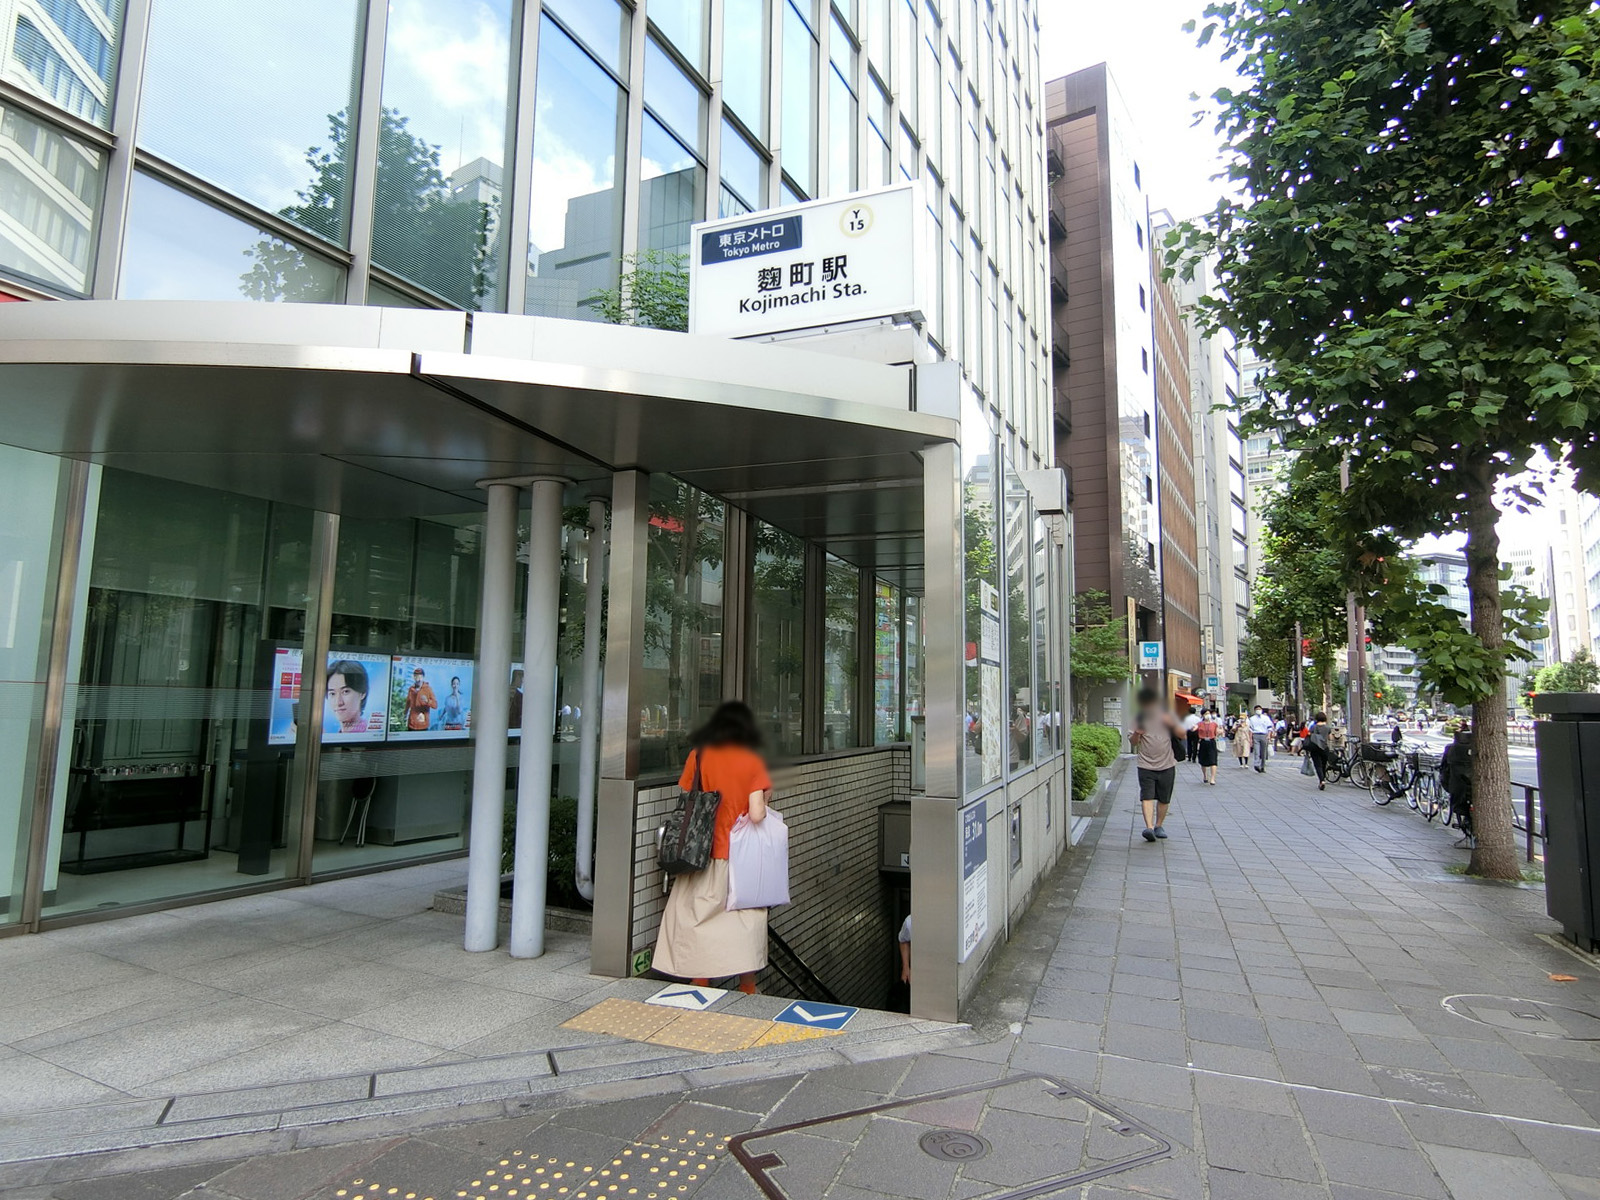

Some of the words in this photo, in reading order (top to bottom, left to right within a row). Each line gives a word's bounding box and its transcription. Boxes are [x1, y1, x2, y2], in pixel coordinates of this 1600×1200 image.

[853, 209, 861, 219] Y
[849, 219, 865, 231] 15
[718, 223, 785, 248] 東京メトロ
[723, 246, 750, 258] Tokyo
[752, 240, 780, 253] Metro
[739, 286, 826, 314] Kojimachi
[832, 283, 867, 299] Sta.
